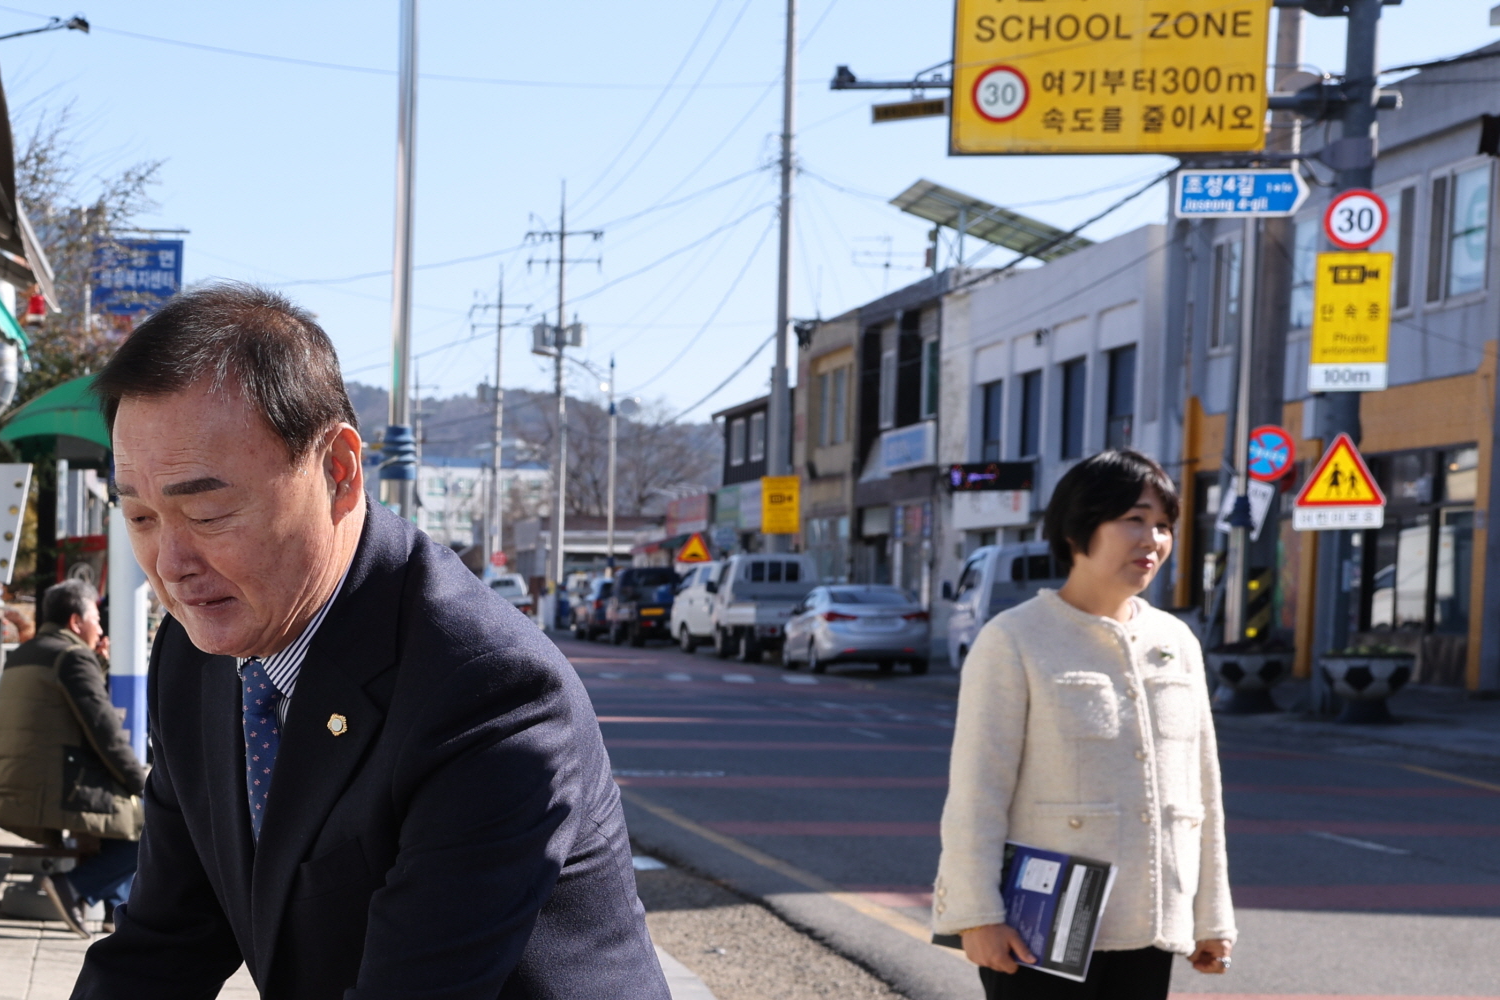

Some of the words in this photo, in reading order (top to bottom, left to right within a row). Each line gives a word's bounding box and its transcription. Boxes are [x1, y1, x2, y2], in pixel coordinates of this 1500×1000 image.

[975, 13, 1132, 42] SCHOOL
[1148, 10, 1252, 39] ZONE
[983, 81, 1018, 106] 30
[1042, 66, 1257, 96] 여기부터300m
[1042, 106, 1123, 134] 속도를
[1142, 104, 1256, 133] 줄이시오
[1184, 174, 1255, 198] 조성4길
[1337, 207, 1375, 234] 30
[1324, 368, 1371, 384] 100m
